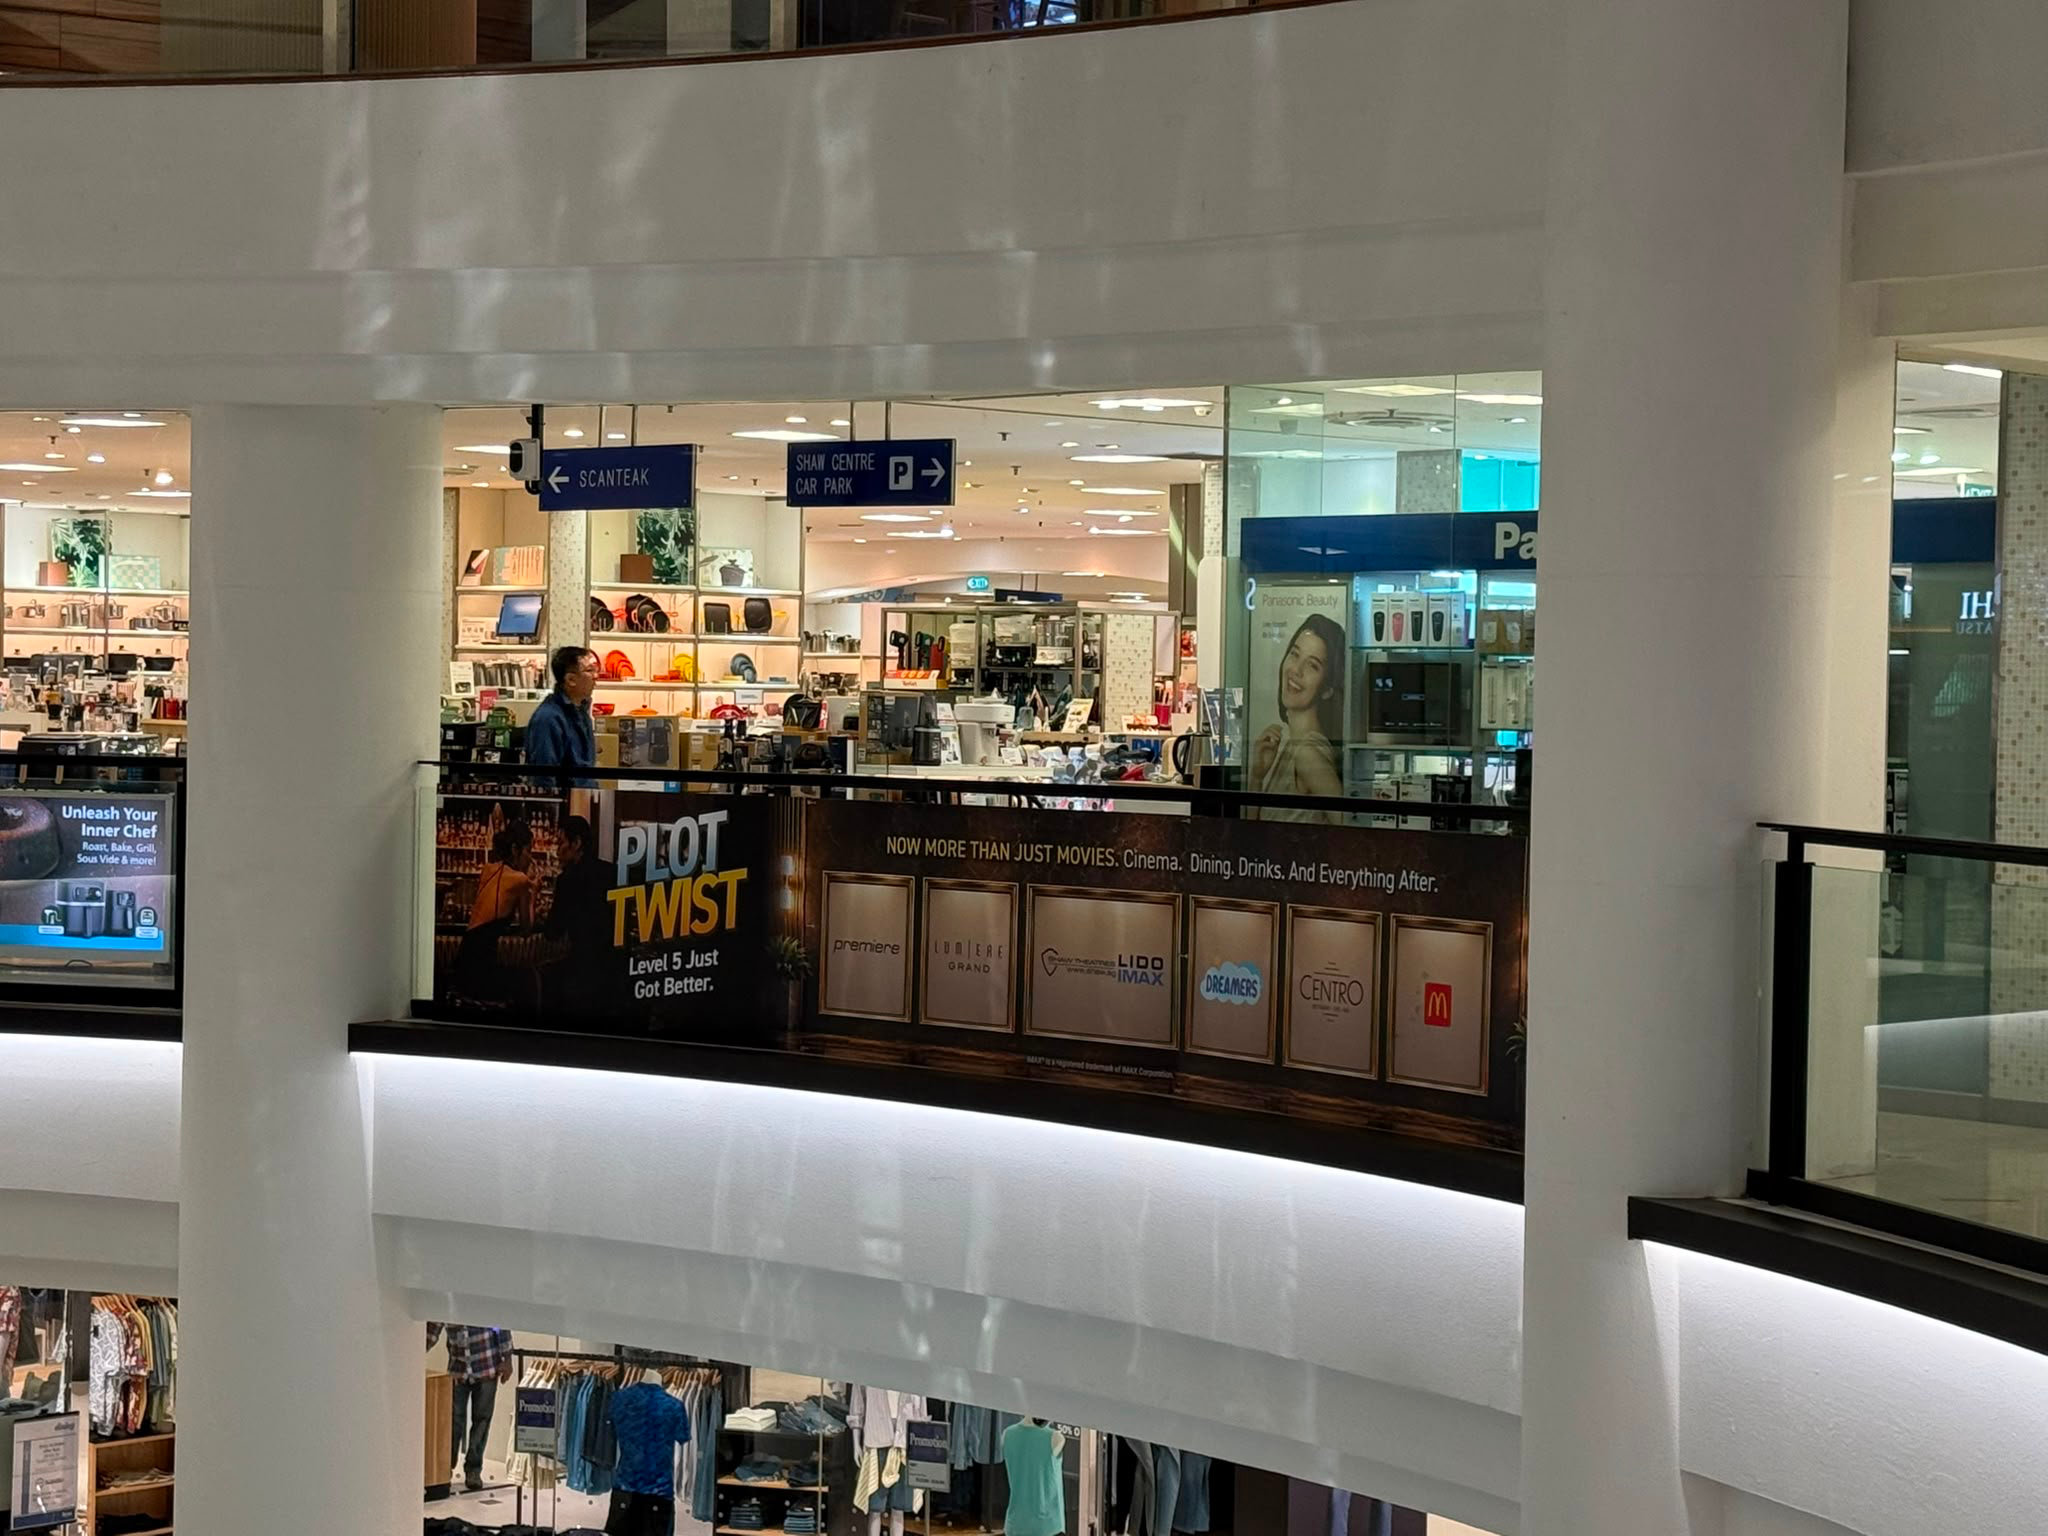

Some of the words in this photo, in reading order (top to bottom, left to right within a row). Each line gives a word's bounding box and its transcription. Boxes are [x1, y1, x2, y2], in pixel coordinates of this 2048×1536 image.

[796, 454, 825, 472] SHAW
[832, 453, 875, 471] CENTRE
[579, 468, 650, 488] SCANTEAK
[895, 461, 908, 484] P
[796, 478, 818, 495] CAR
[824, 477, 853, 495] PARK
[1262, 594, 1304, 607] Panasonic
[1307, 593, 1338, 609] Beauty
[62, 805, 120, 820] Unleash
[123, 807, 158, 822] Your
[81, 823, 120, 838] Inner
[123, 824, 158, 838] Chef
[82, 841, 109, 853] Roast,
[111, 842, 134, 853] Bake,
[136, 843, 157, 854] Grill,
[617, 810, 729, 887] PLOT
[77, 853, 98, 864] Sous
[99, 854, 119, 865] Vide
[121, 856, 128, 865] &
[130, 856, 157, 865] more!
[886, 836, 921, 855] NOW
[925, 838, 966, 858] MORE
[970, 840, 1010, 861] THAN
[1014, 843, 1053, 863] JUST
[1057, 845, 1119, 867] MOVIES.
[1124, 848, 1182, 871] Cinema.
[1190, 853, 1234, 880] Dining.
[1238, 857, 1285, 881] Drinks.
[1288, 860, 1315, 882] And
[1319, 863, 1395, 894] Everything
[1398, 869, 1438, 893] After.
[607, 867, 748, 946] TWIST
[833, 939, 900, 955] premiere
[629, 954, 668, 975] Level
[672, 952, 682, 970] 5
[685, 949, 719, 969] Just
[948, 961, 991, 974] GRAND
[1118, 954, 1164, 971] LIDO
[1118, 969, 1164, 986] IMAX
[1205, 974, 1259, 999] DREAMERS
[635, 979, 660, 999] Got
[664, 976, 714, 996] Better.
[1300, 974, 1364, 1007] CENTRO
[909, 1432, 948, 1449] Promotion
